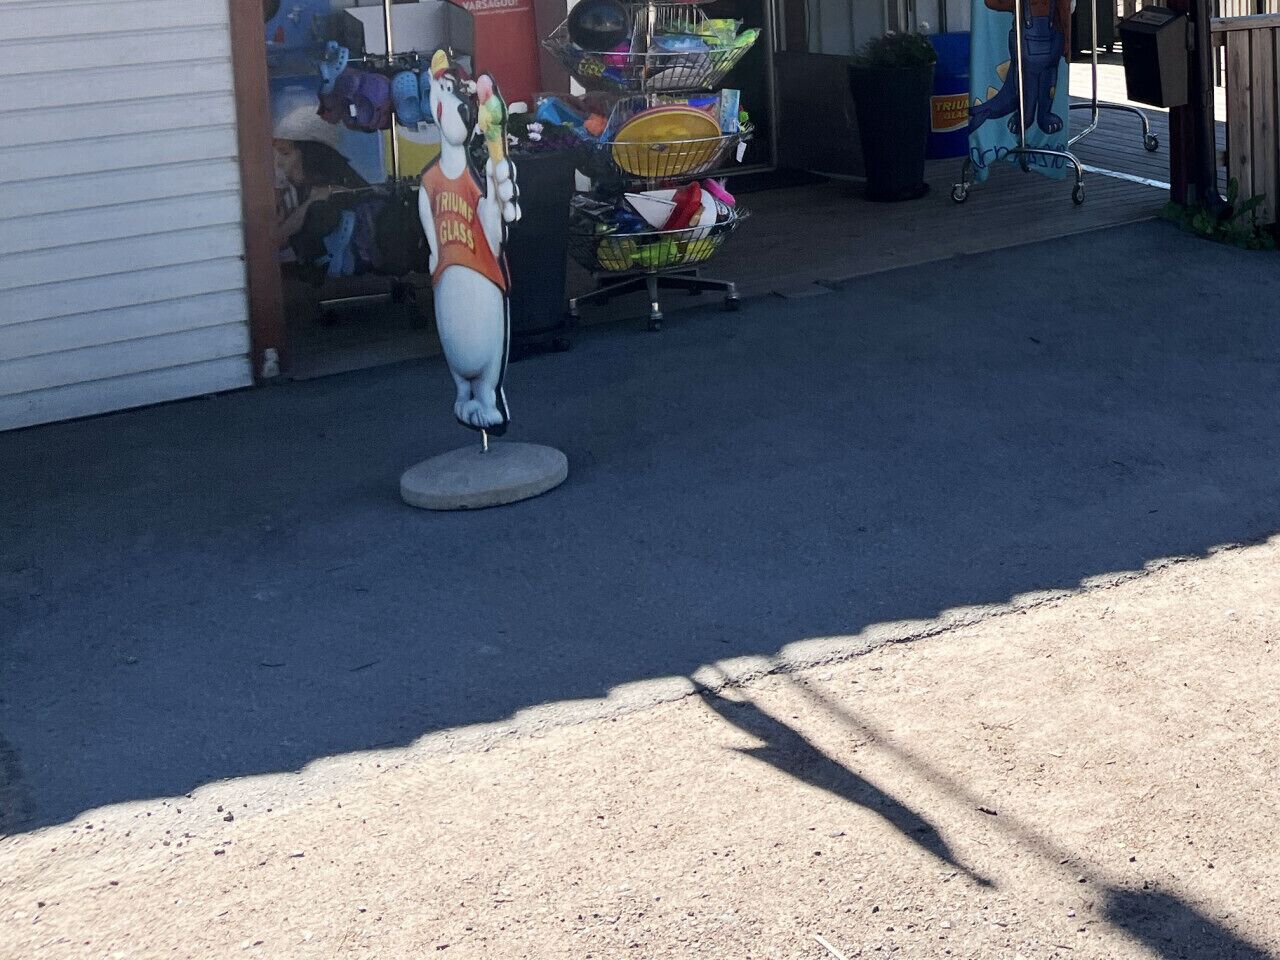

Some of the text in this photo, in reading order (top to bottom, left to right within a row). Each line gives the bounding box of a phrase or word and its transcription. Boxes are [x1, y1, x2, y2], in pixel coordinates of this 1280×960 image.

[935, 99, 969, 111] TRIU
[944, 111, 969, 120] GLAS
[435, 191, 474, 223] TRIUMF
[440, 219, 475, 250] GLASS
